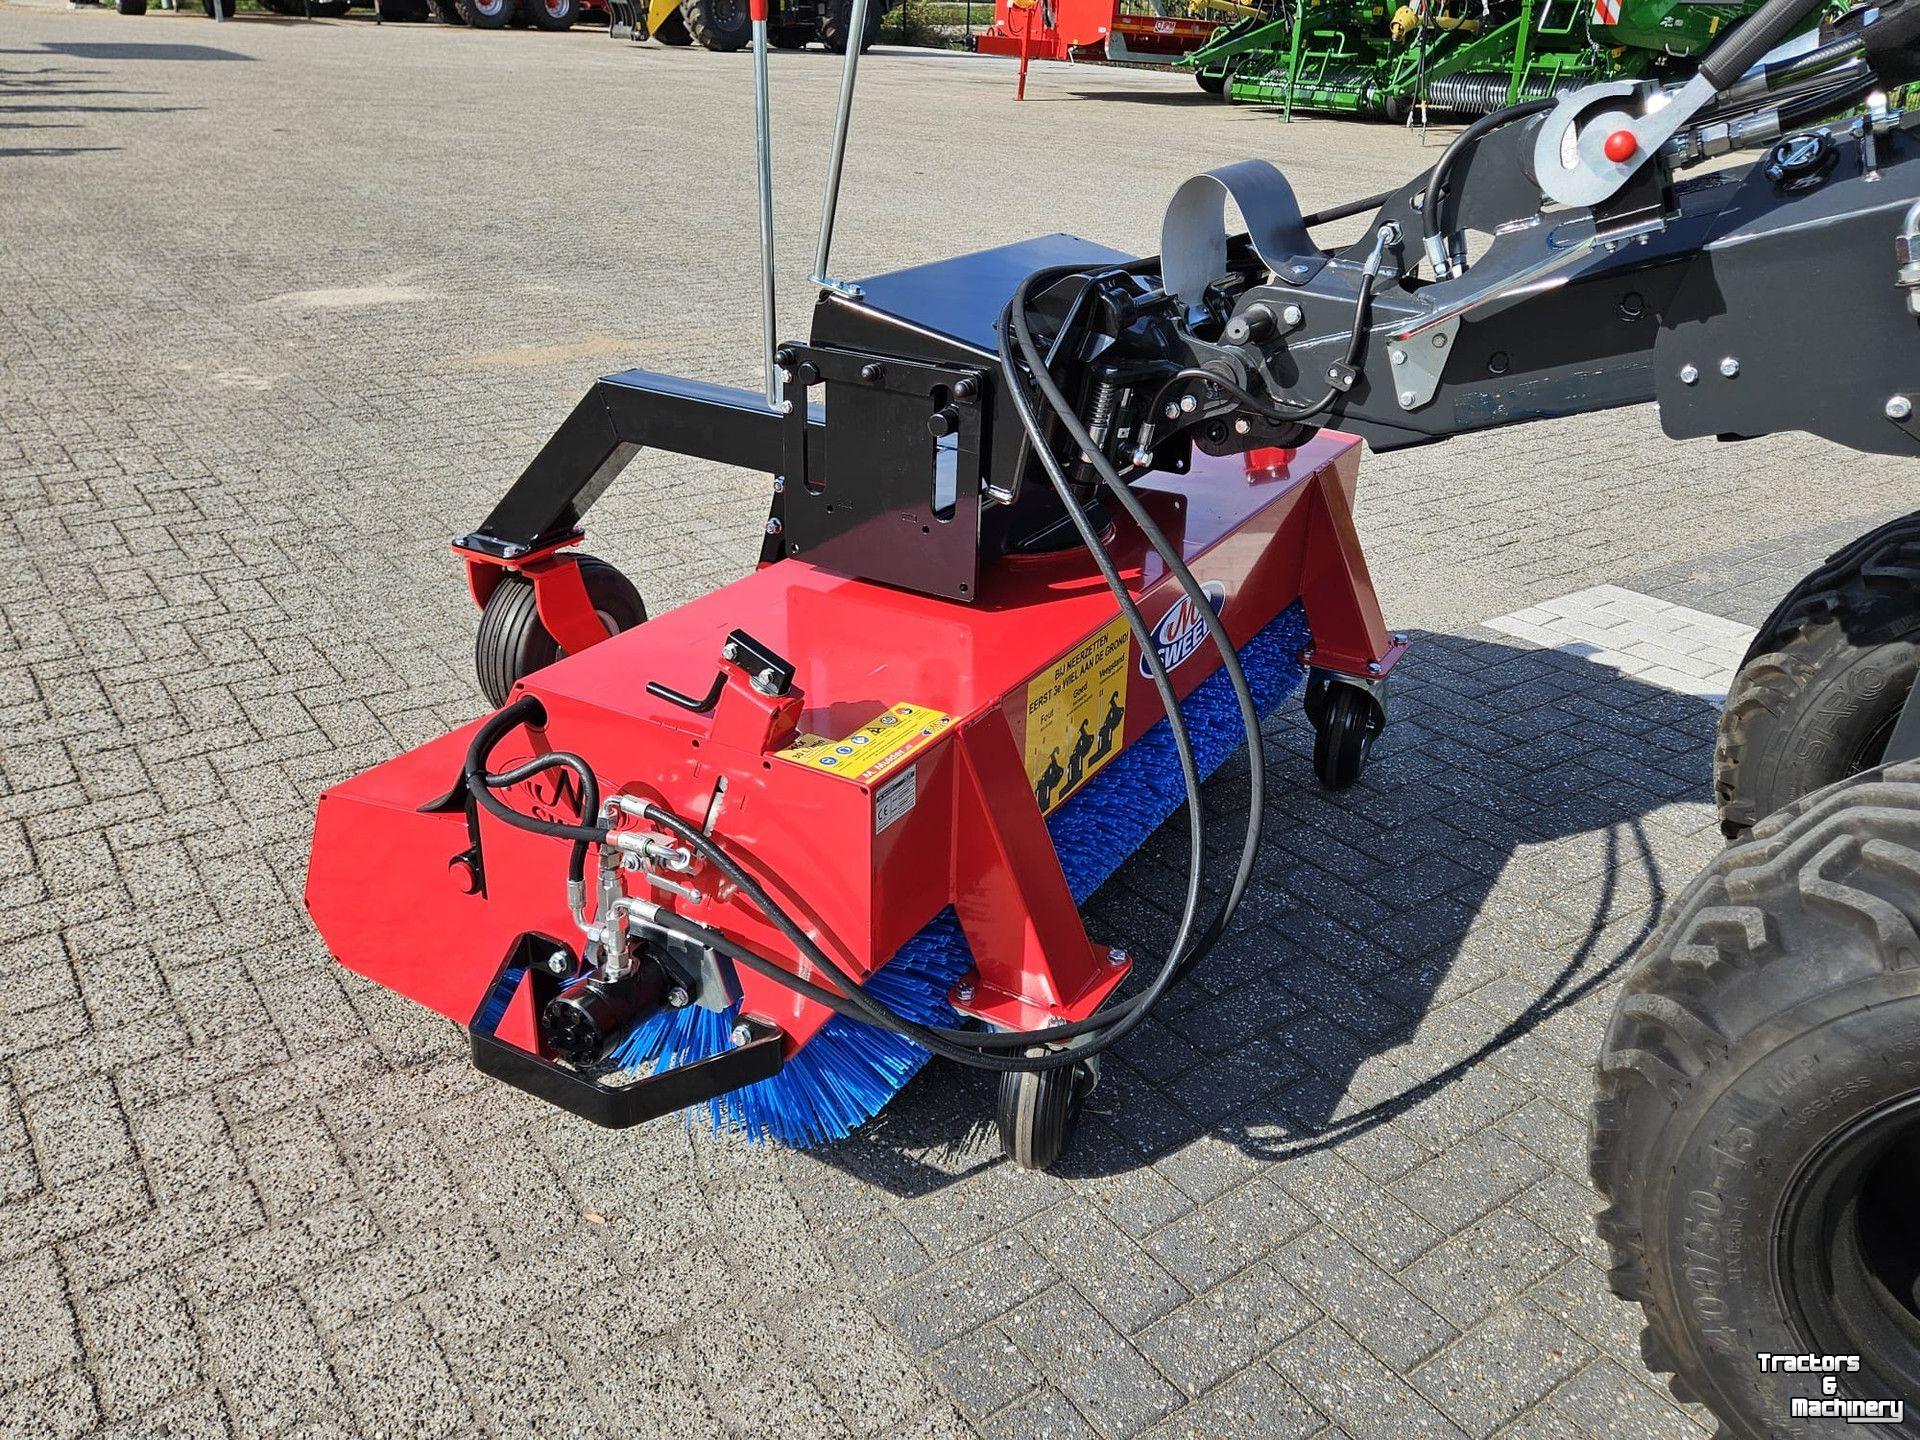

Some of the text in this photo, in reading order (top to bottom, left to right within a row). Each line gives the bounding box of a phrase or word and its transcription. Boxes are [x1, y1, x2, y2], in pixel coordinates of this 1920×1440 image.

[1054, 633, 1109, 680] BIJ NEERZETTEN
[1158, 618, 1208, 668] SWEE
[1028, 689, 1053, 715] EERST
[1062, 673, 1079, 690] WIEL
[1080, 658, 1095, 676] AAN
[1095, 651, 1104, 665] DE
[1105, 632, 1129, 657] GROND!
[1072, 681, 1088, 699] Goed
[1040, 708, 1054, 725] Fout
